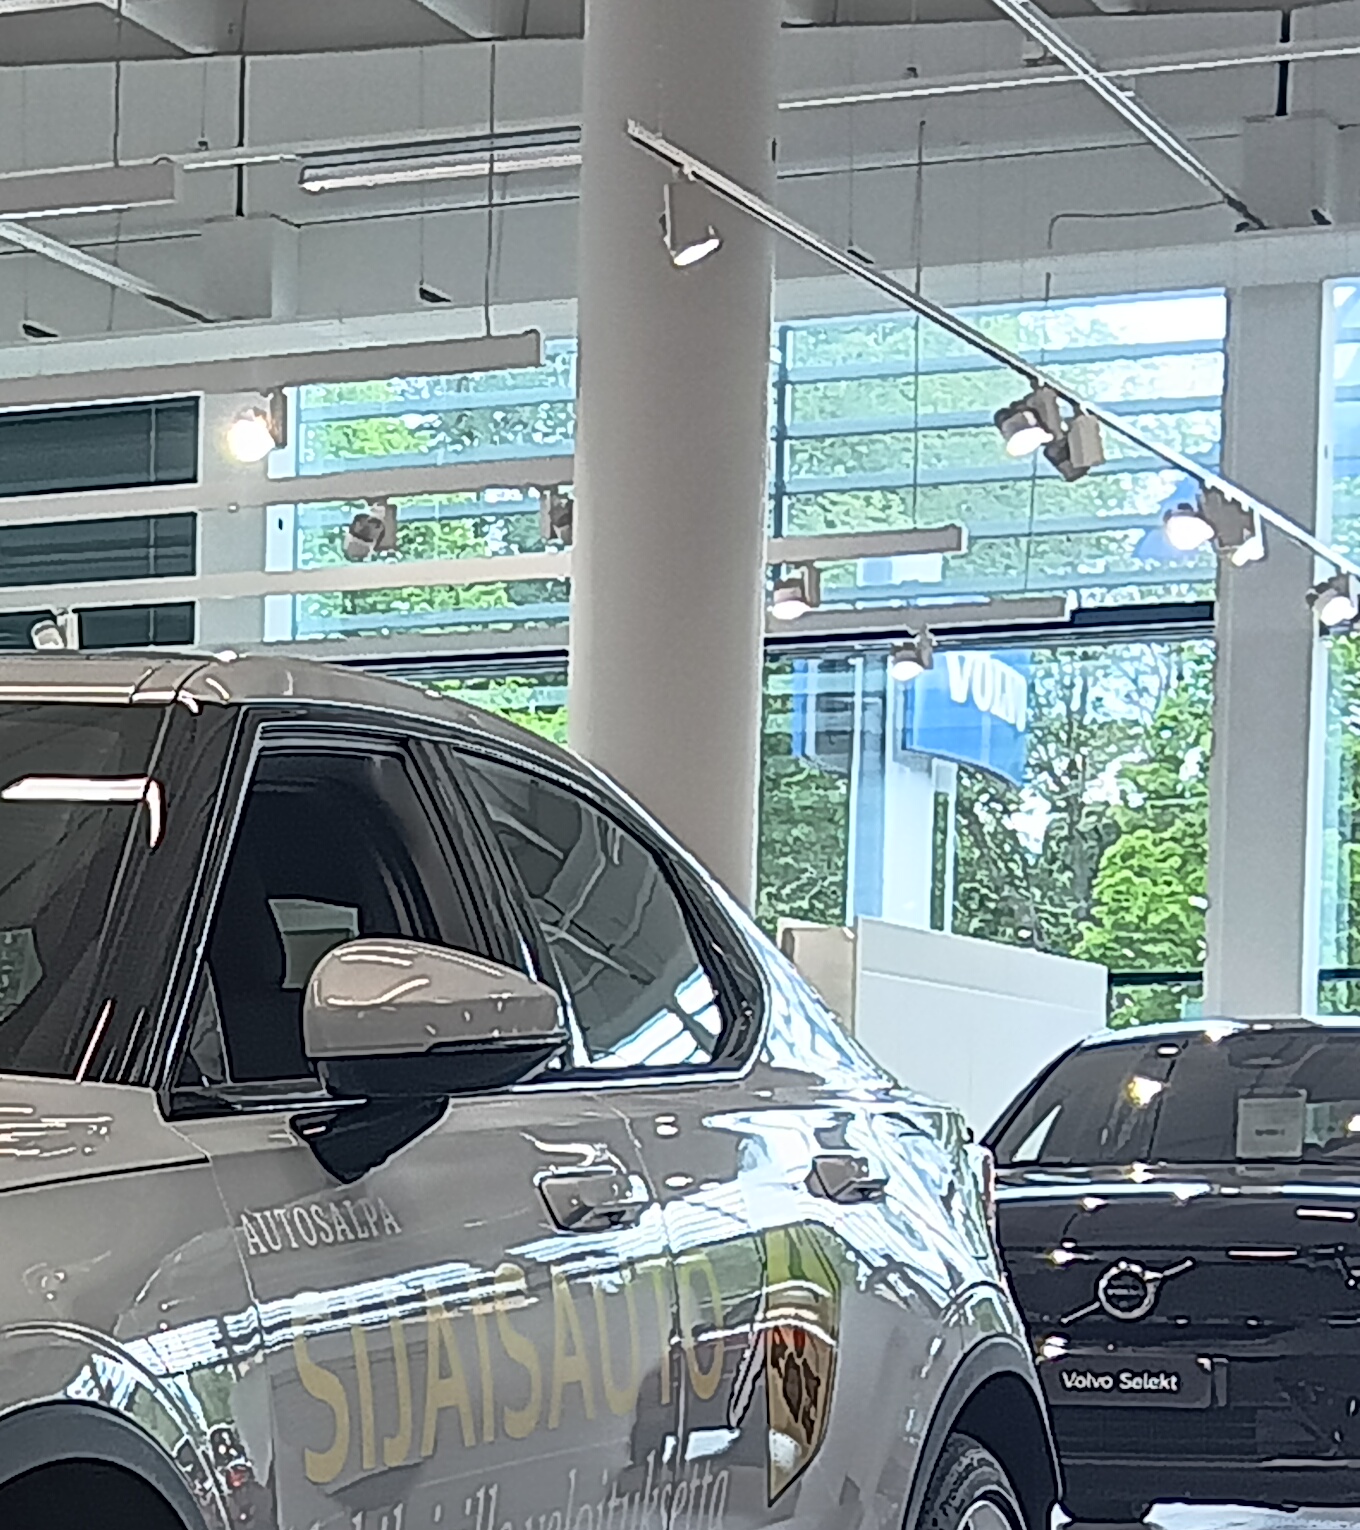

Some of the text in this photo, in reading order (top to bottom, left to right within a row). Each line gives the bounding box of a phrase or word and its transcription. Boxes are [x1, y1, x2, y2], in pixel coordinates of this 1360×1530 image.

[240, 1198, 402, 1255] AUTOSALPA
[293, 1253, 725, 1484] SIJAISAUTO
[1062, 1371, 1178, 1392] Volvo Selekt
